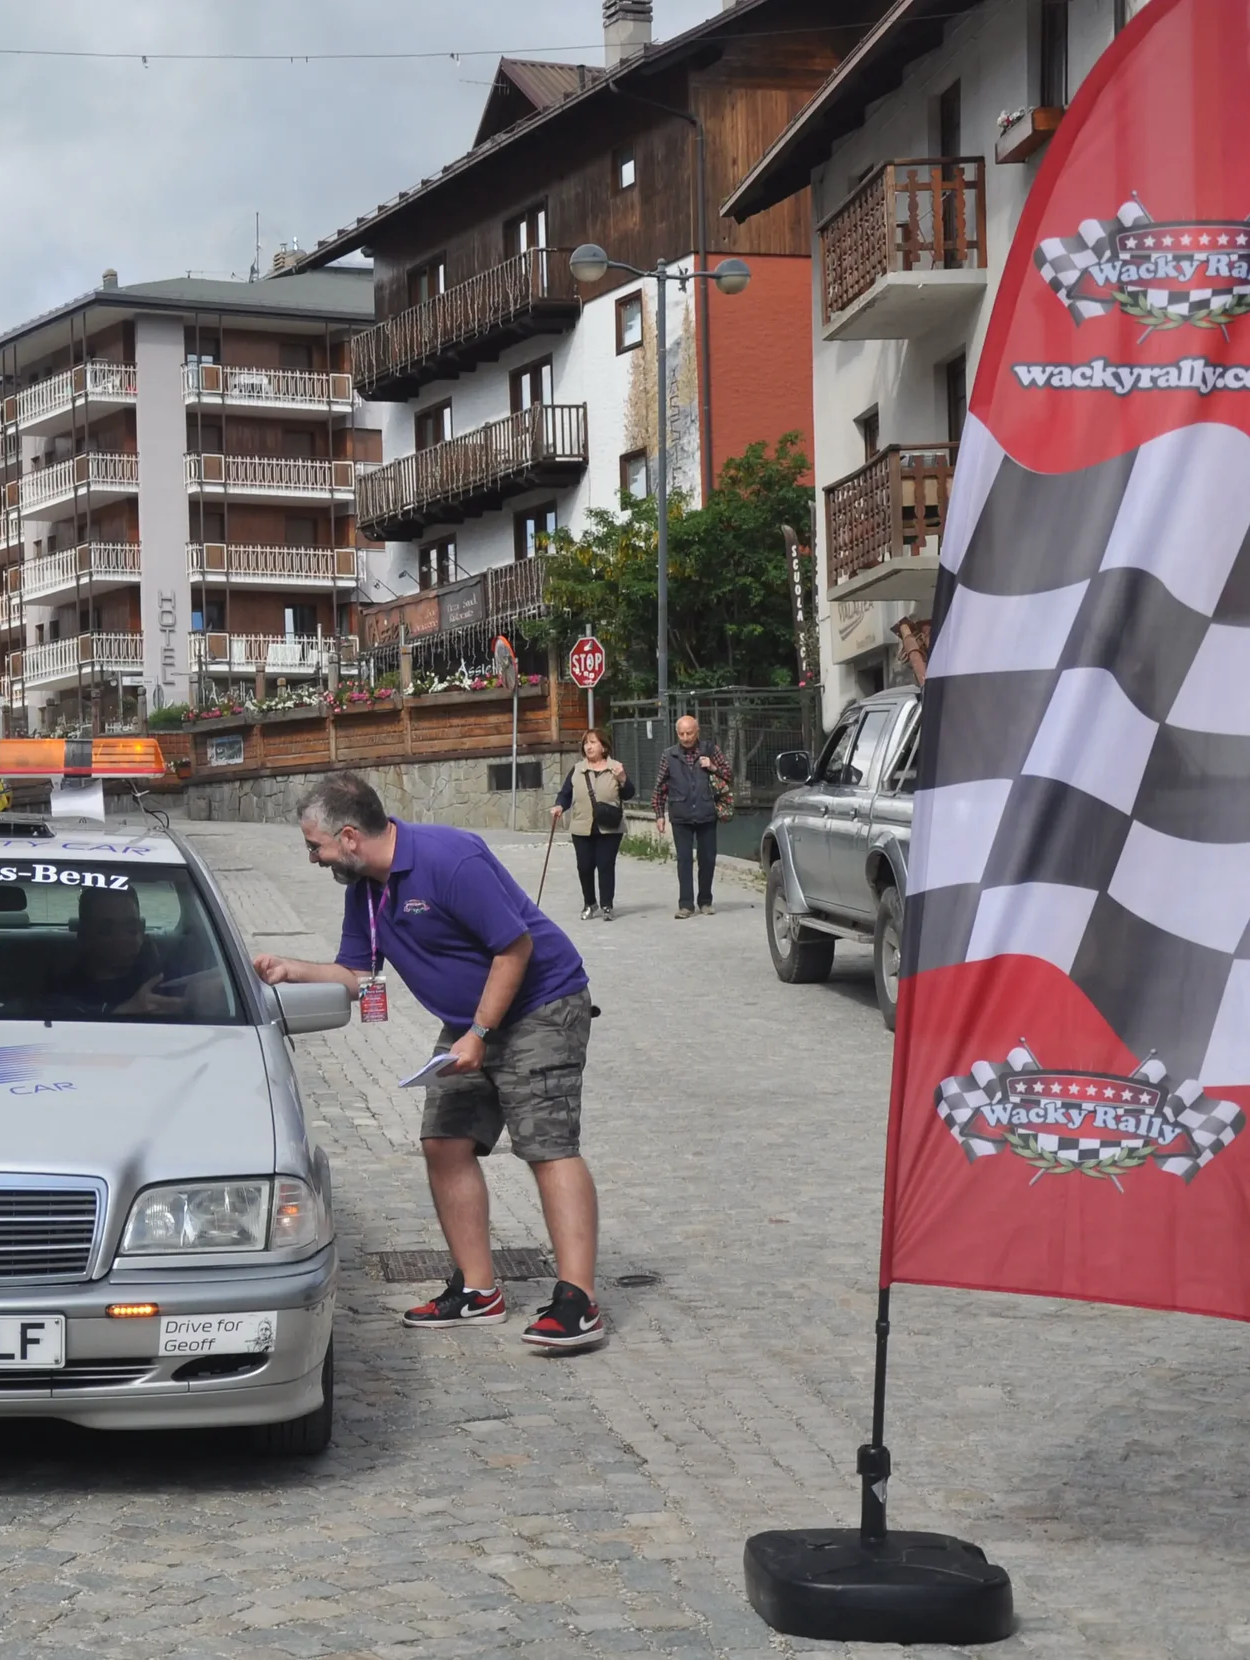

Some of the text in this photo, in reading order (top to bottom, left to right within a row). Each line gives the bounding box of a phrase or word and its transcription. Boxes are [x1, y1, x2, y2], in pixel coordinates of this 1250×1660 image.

[1088, 254, 1250, 287] Wacky Ra
[1012, 358, 1250, 395] wackyrally.c
[791, 544, 804, 622] SCUOLA
[158, 588, 176, 686] HOTEL
[572, 652, 602, 673] STOP
[61, 842, 154, 856] CAR
[9, 1081, 78, 1096] CAR
[980, 1101, 1182, 1145] Wacky Rally
[165, 1319, 243, 1334] Drive for
[164, 1338, 217, 1352] Geoff
